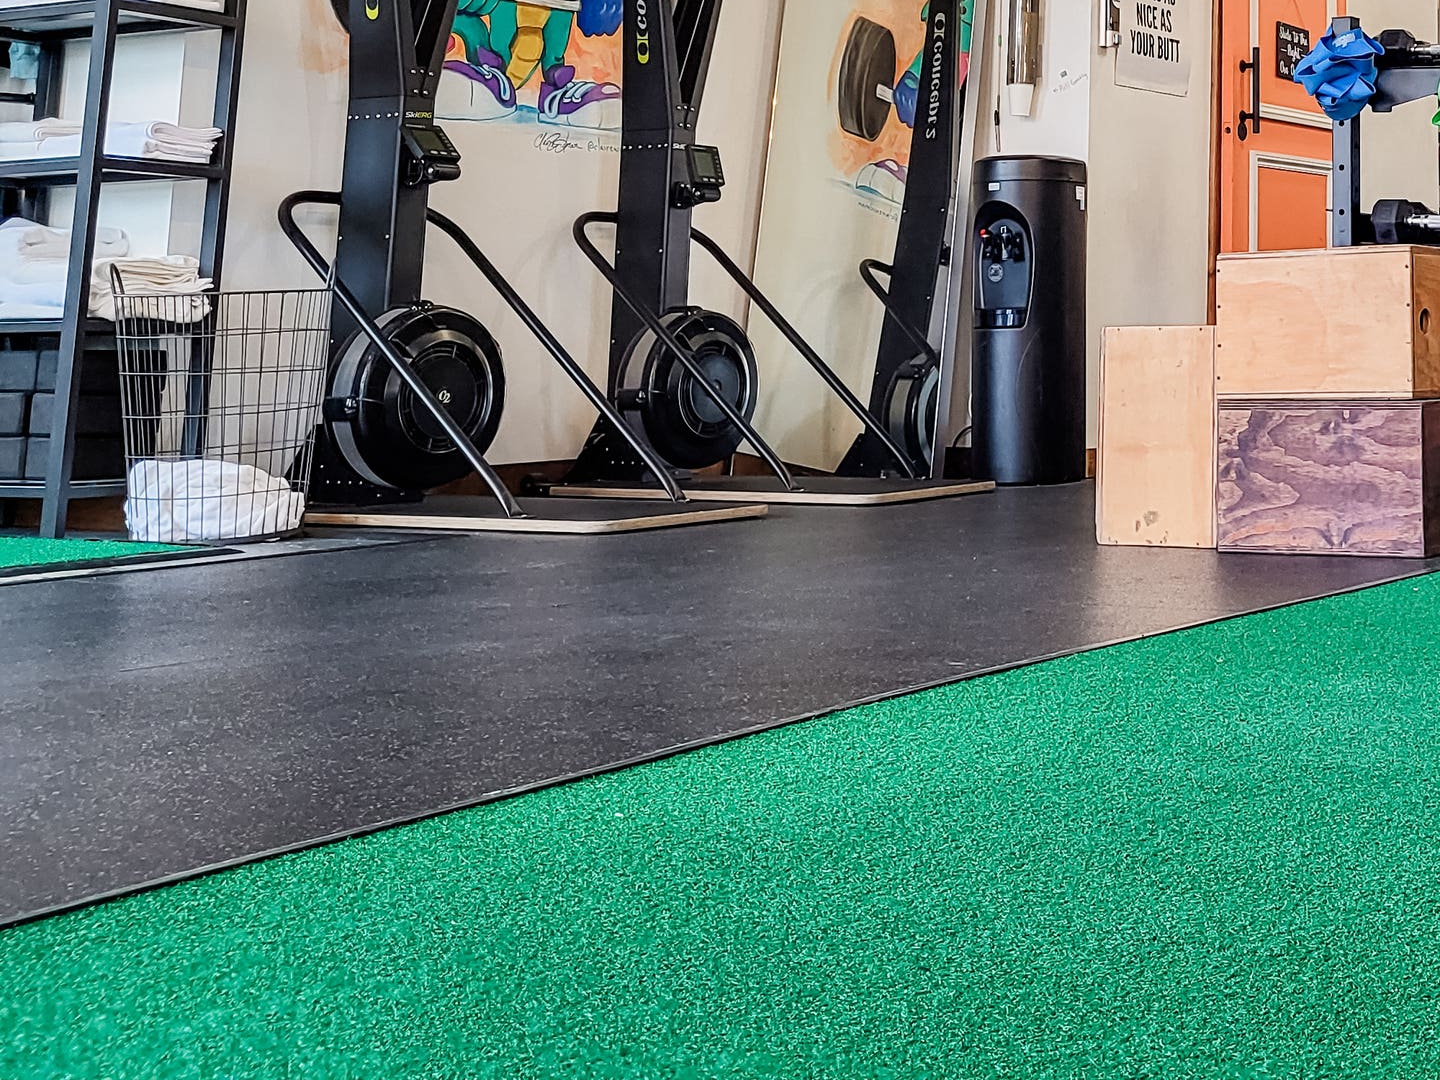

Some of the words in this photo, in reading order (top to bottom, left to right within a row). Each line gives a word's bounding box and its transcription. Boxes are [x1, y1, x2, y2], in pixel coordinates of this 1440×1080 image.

[1136, 2, 1158, 30] NICE
[1161, 8, 1172, 33] AS
[1130, 28, 1155, 58] YOUR
[1157, 35, 1180, 63] BUTT
